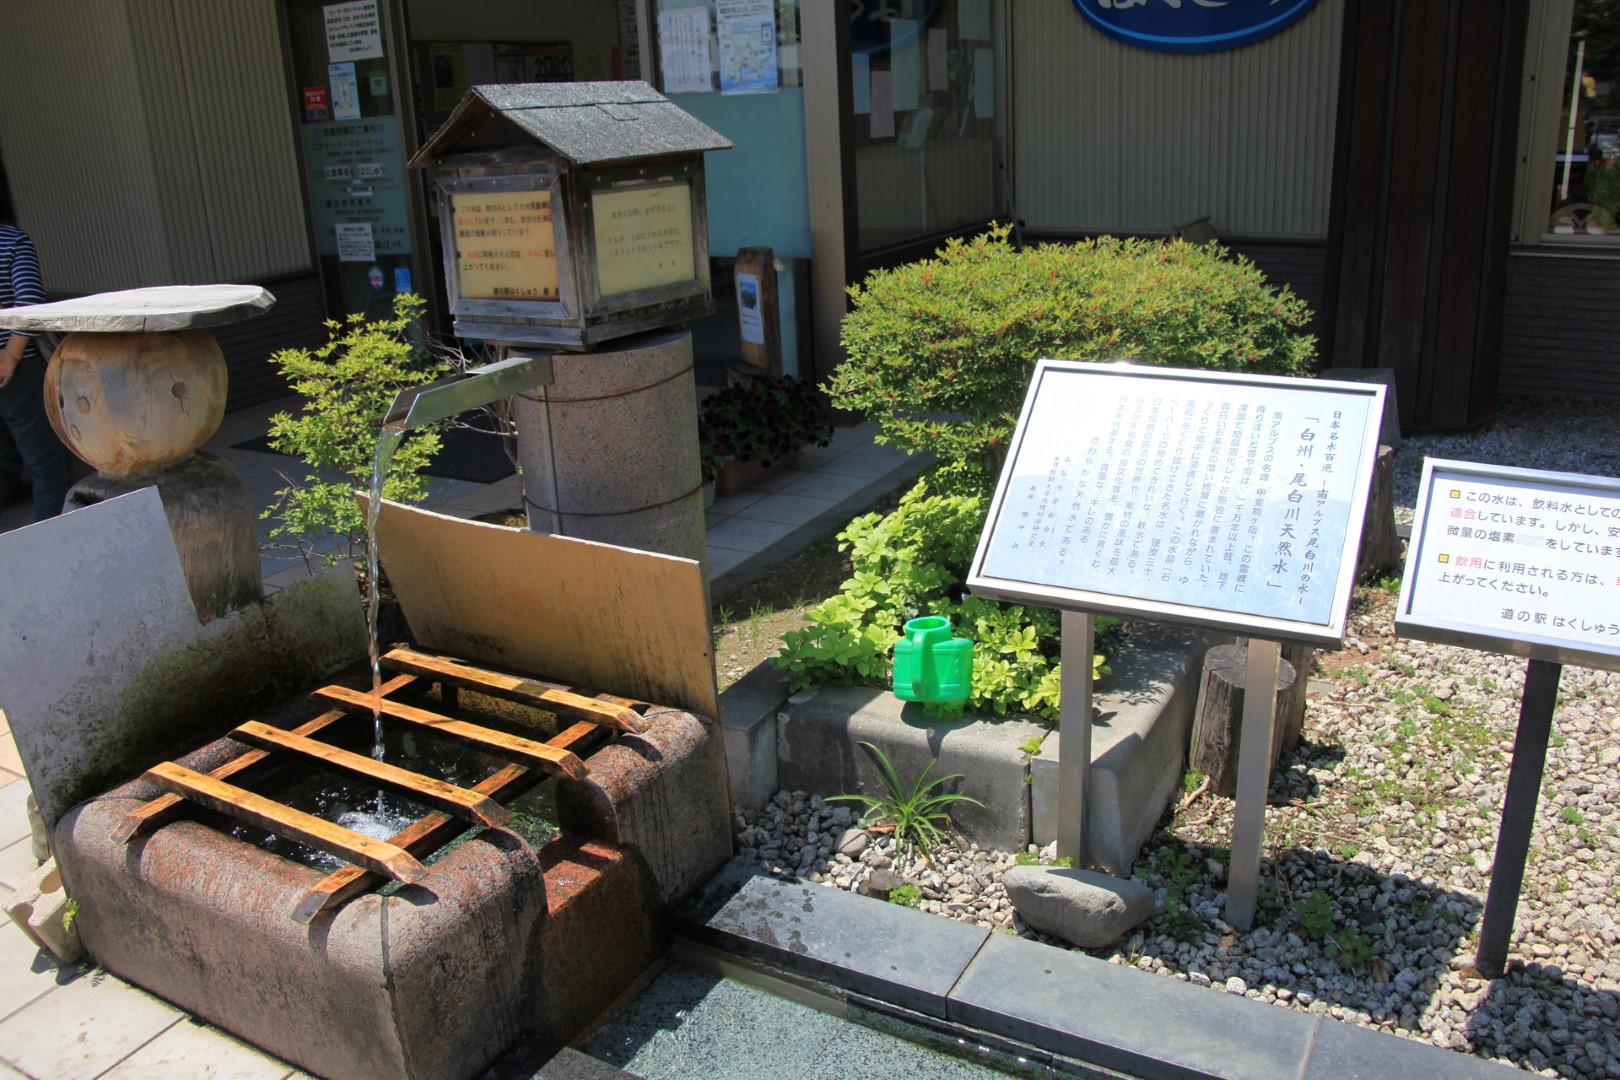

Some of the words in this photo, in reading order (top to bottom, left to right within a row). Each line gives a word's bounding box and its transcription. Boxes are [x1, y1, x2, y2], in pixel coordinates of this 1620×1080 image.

[1267, 416, 1319, 588] 「白州・尾白川天然水」
[1438, 572, 1549, 598] 上がってください。
